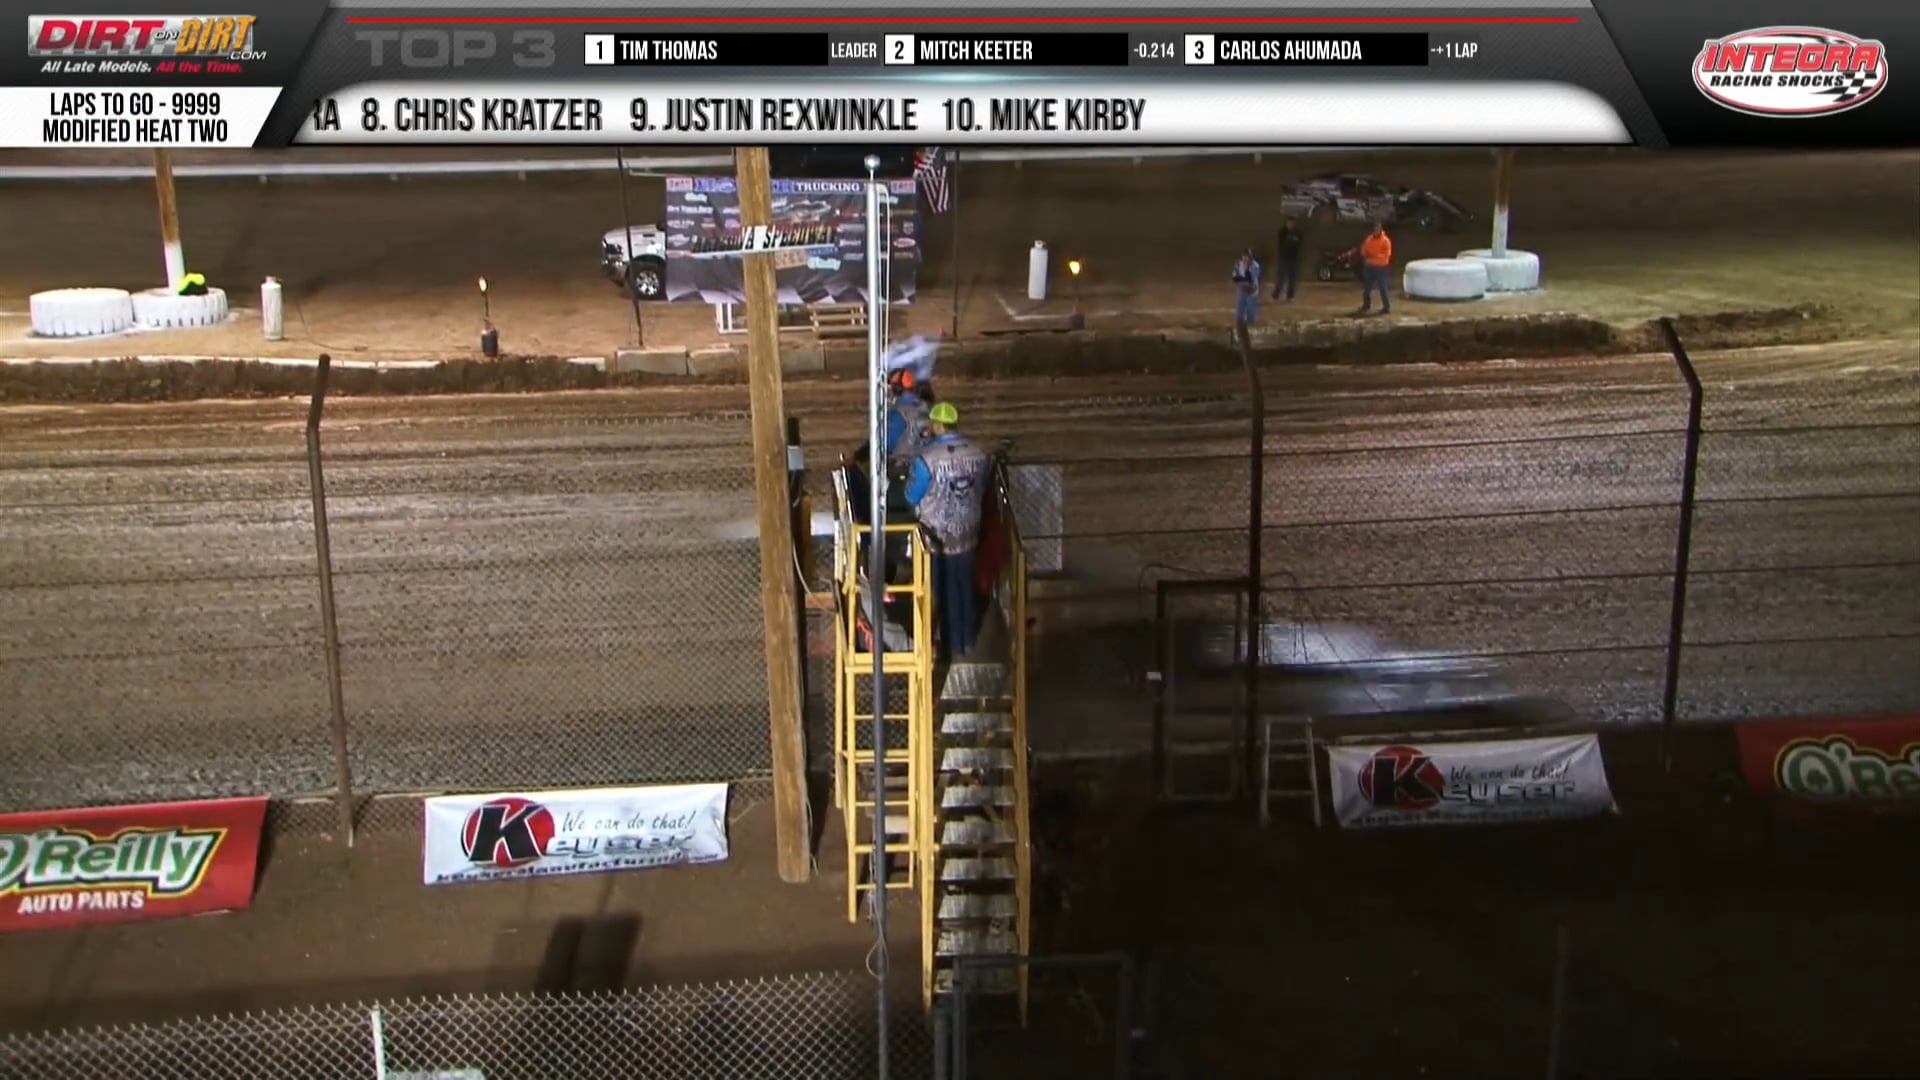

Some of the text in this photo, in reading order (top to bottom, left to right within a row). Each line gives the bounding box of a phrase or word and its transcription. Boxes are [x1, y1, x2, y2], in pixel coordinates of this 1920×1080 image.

[796, 182, 861, 193] TRUCKING
[562, 809, 698, 833] We can do that!
[18, 889, 145, 915] AUTO PARTS
